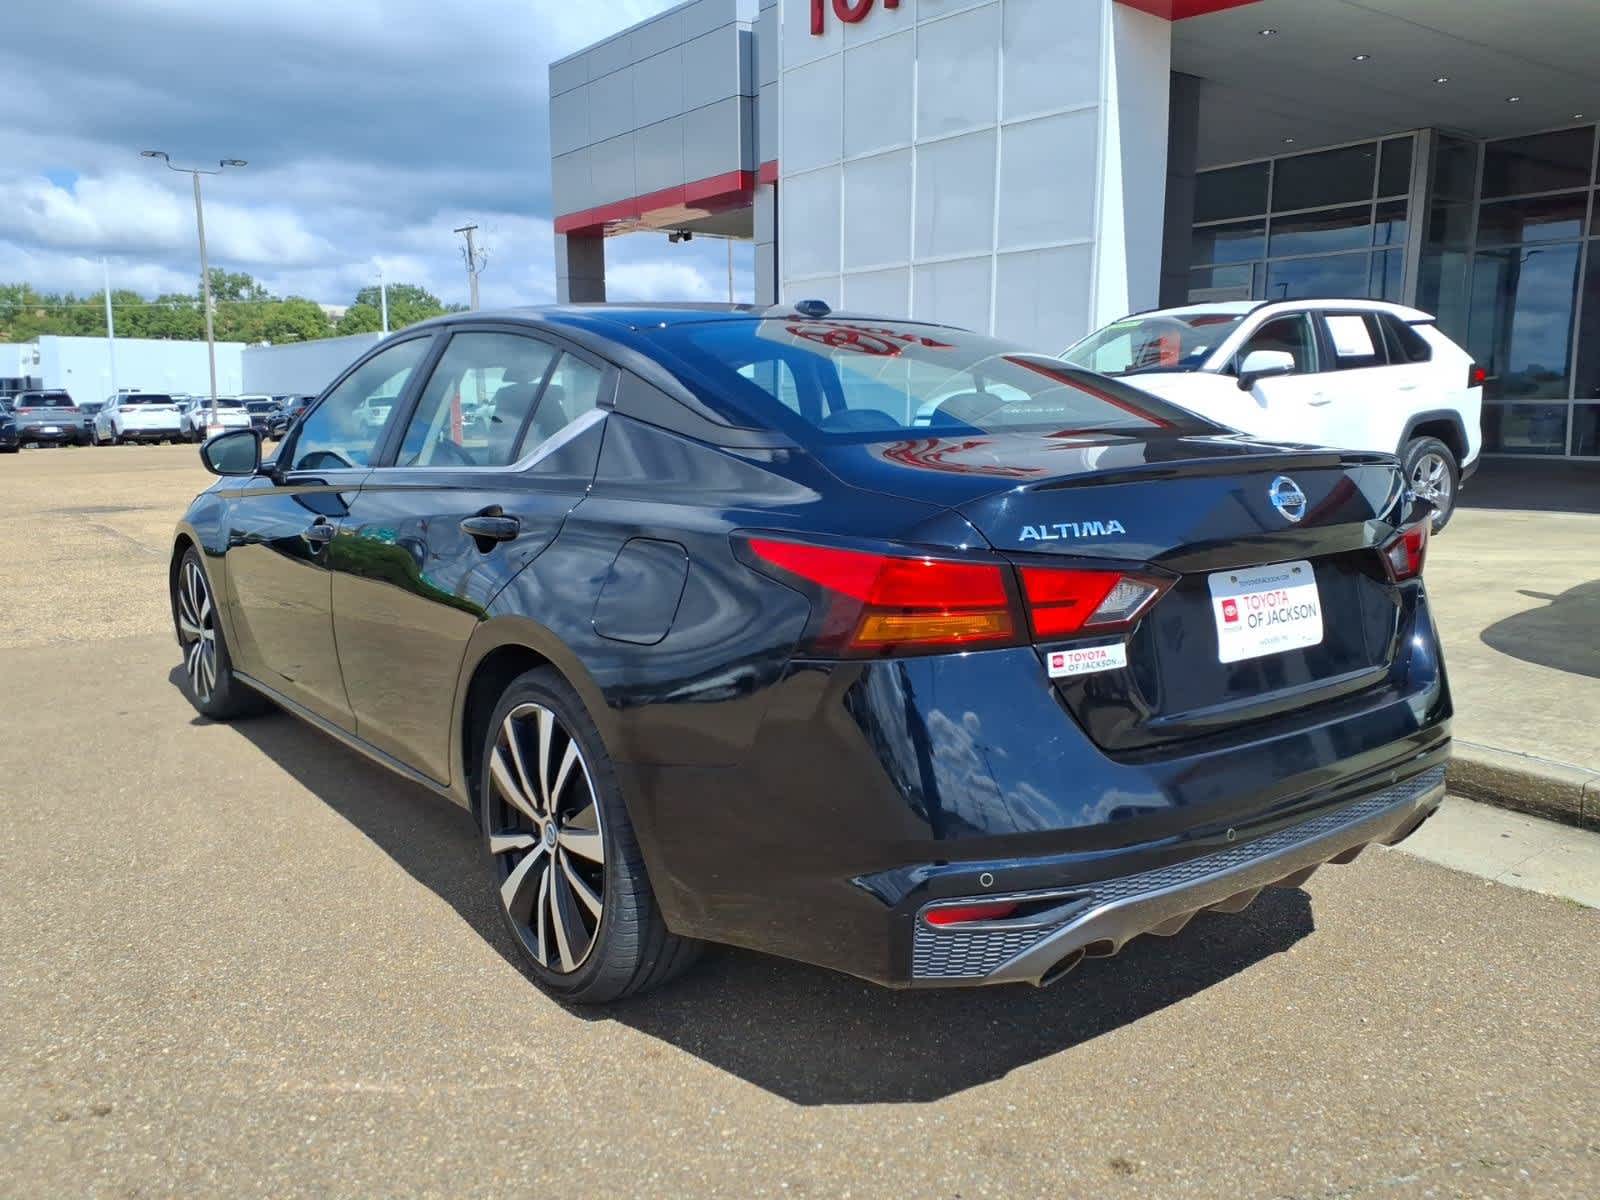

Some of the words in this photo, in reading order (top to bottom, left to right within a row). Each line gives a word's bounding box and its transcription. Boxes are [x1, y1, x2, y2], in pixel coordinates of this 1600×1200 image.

[1019, 520, 1126, 541] ALTIMA
[1243, 591, 1289, 610] TOYOTA
[1247, 612, 1263, 629] OF
[1266, 604, 1317, 626] JACKSON
[1068, 651, 1107, 662] TOYOTA
[1068, 664, 1079, 672] OF
[1082, 659, 1116, 669] JACKSON
